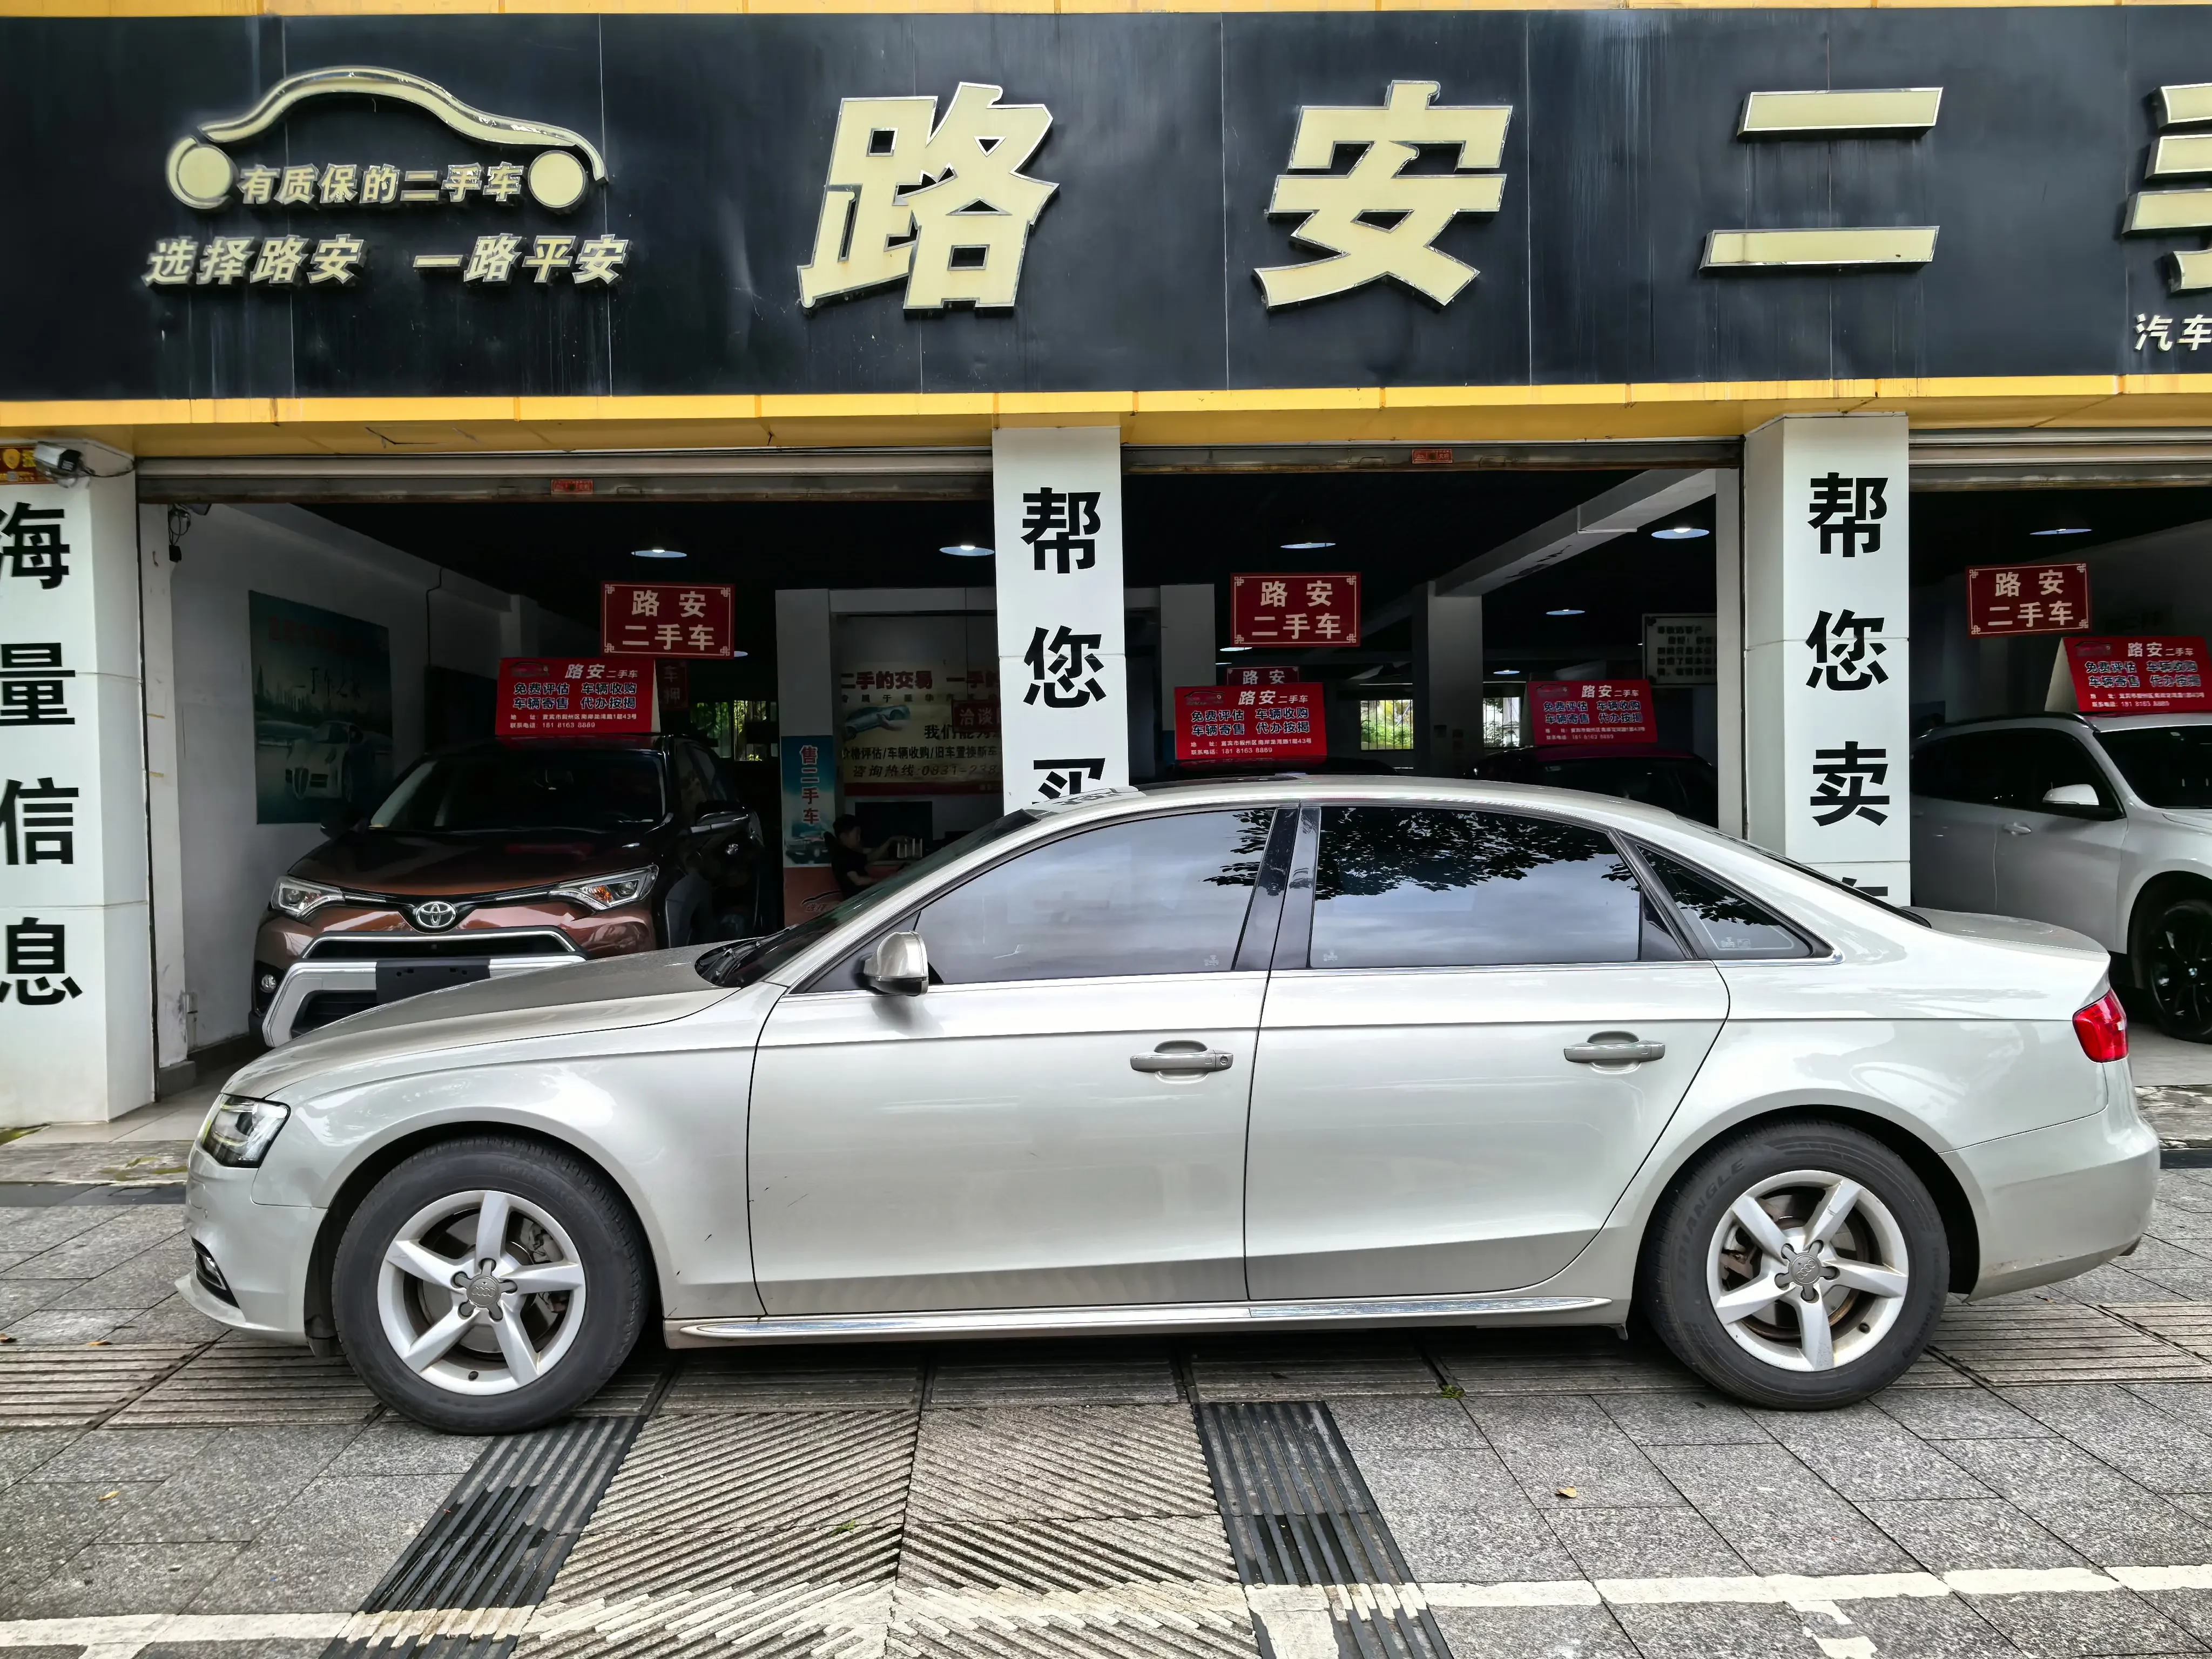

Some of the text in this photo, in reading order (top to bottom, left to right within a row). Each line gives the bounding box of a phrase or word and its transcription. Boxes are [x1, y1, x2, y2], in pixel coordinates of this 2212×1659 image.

[237, 163, 527, 208] 有质保的二手车
[143, 233, 629, 287] 选择路安 一路平安
[2133, 313, 2212, 351] 汽车
[1260, 581, 1333, 607] 路安
[1995, 569, 2065, 597] 路安
[632, 591, 706, 617] 路安
[1987, 600, 2074, 628] 二手车
[1252, 613, 1341, 639] 二手车
[622, 624, 714, 651] 二手车
[2128, 642, 2195, 657] 路安 二手车
[564, 663, 638, 679] 路安 二手车
[841, 671, 933, 690] 二手的交易
[1243, 669, 1285, 685] 路安
[513, 682, 637, 695] 免费评估 车辆收购
[1238, 690, 1309, 705] 路安 二手车
[1581, 685, 1613, 698] 路安
[513, 697, 636, 710] 车辆寄售 代办按揭
[1543, 701, 1588, 712] 免费评估
[959, 707, 999, 726] 洽谈
[1191, 707, 1309, 723] 免费评估 车辆收购
[1191, 721, 1310, 737] 车辆寄售 代办按揭
[0, 502, 83, 1006] 海量信息
[799, 745, 820, 826] 售二手车
[1677, 1157, 1746, 1281] TRIANGLE
